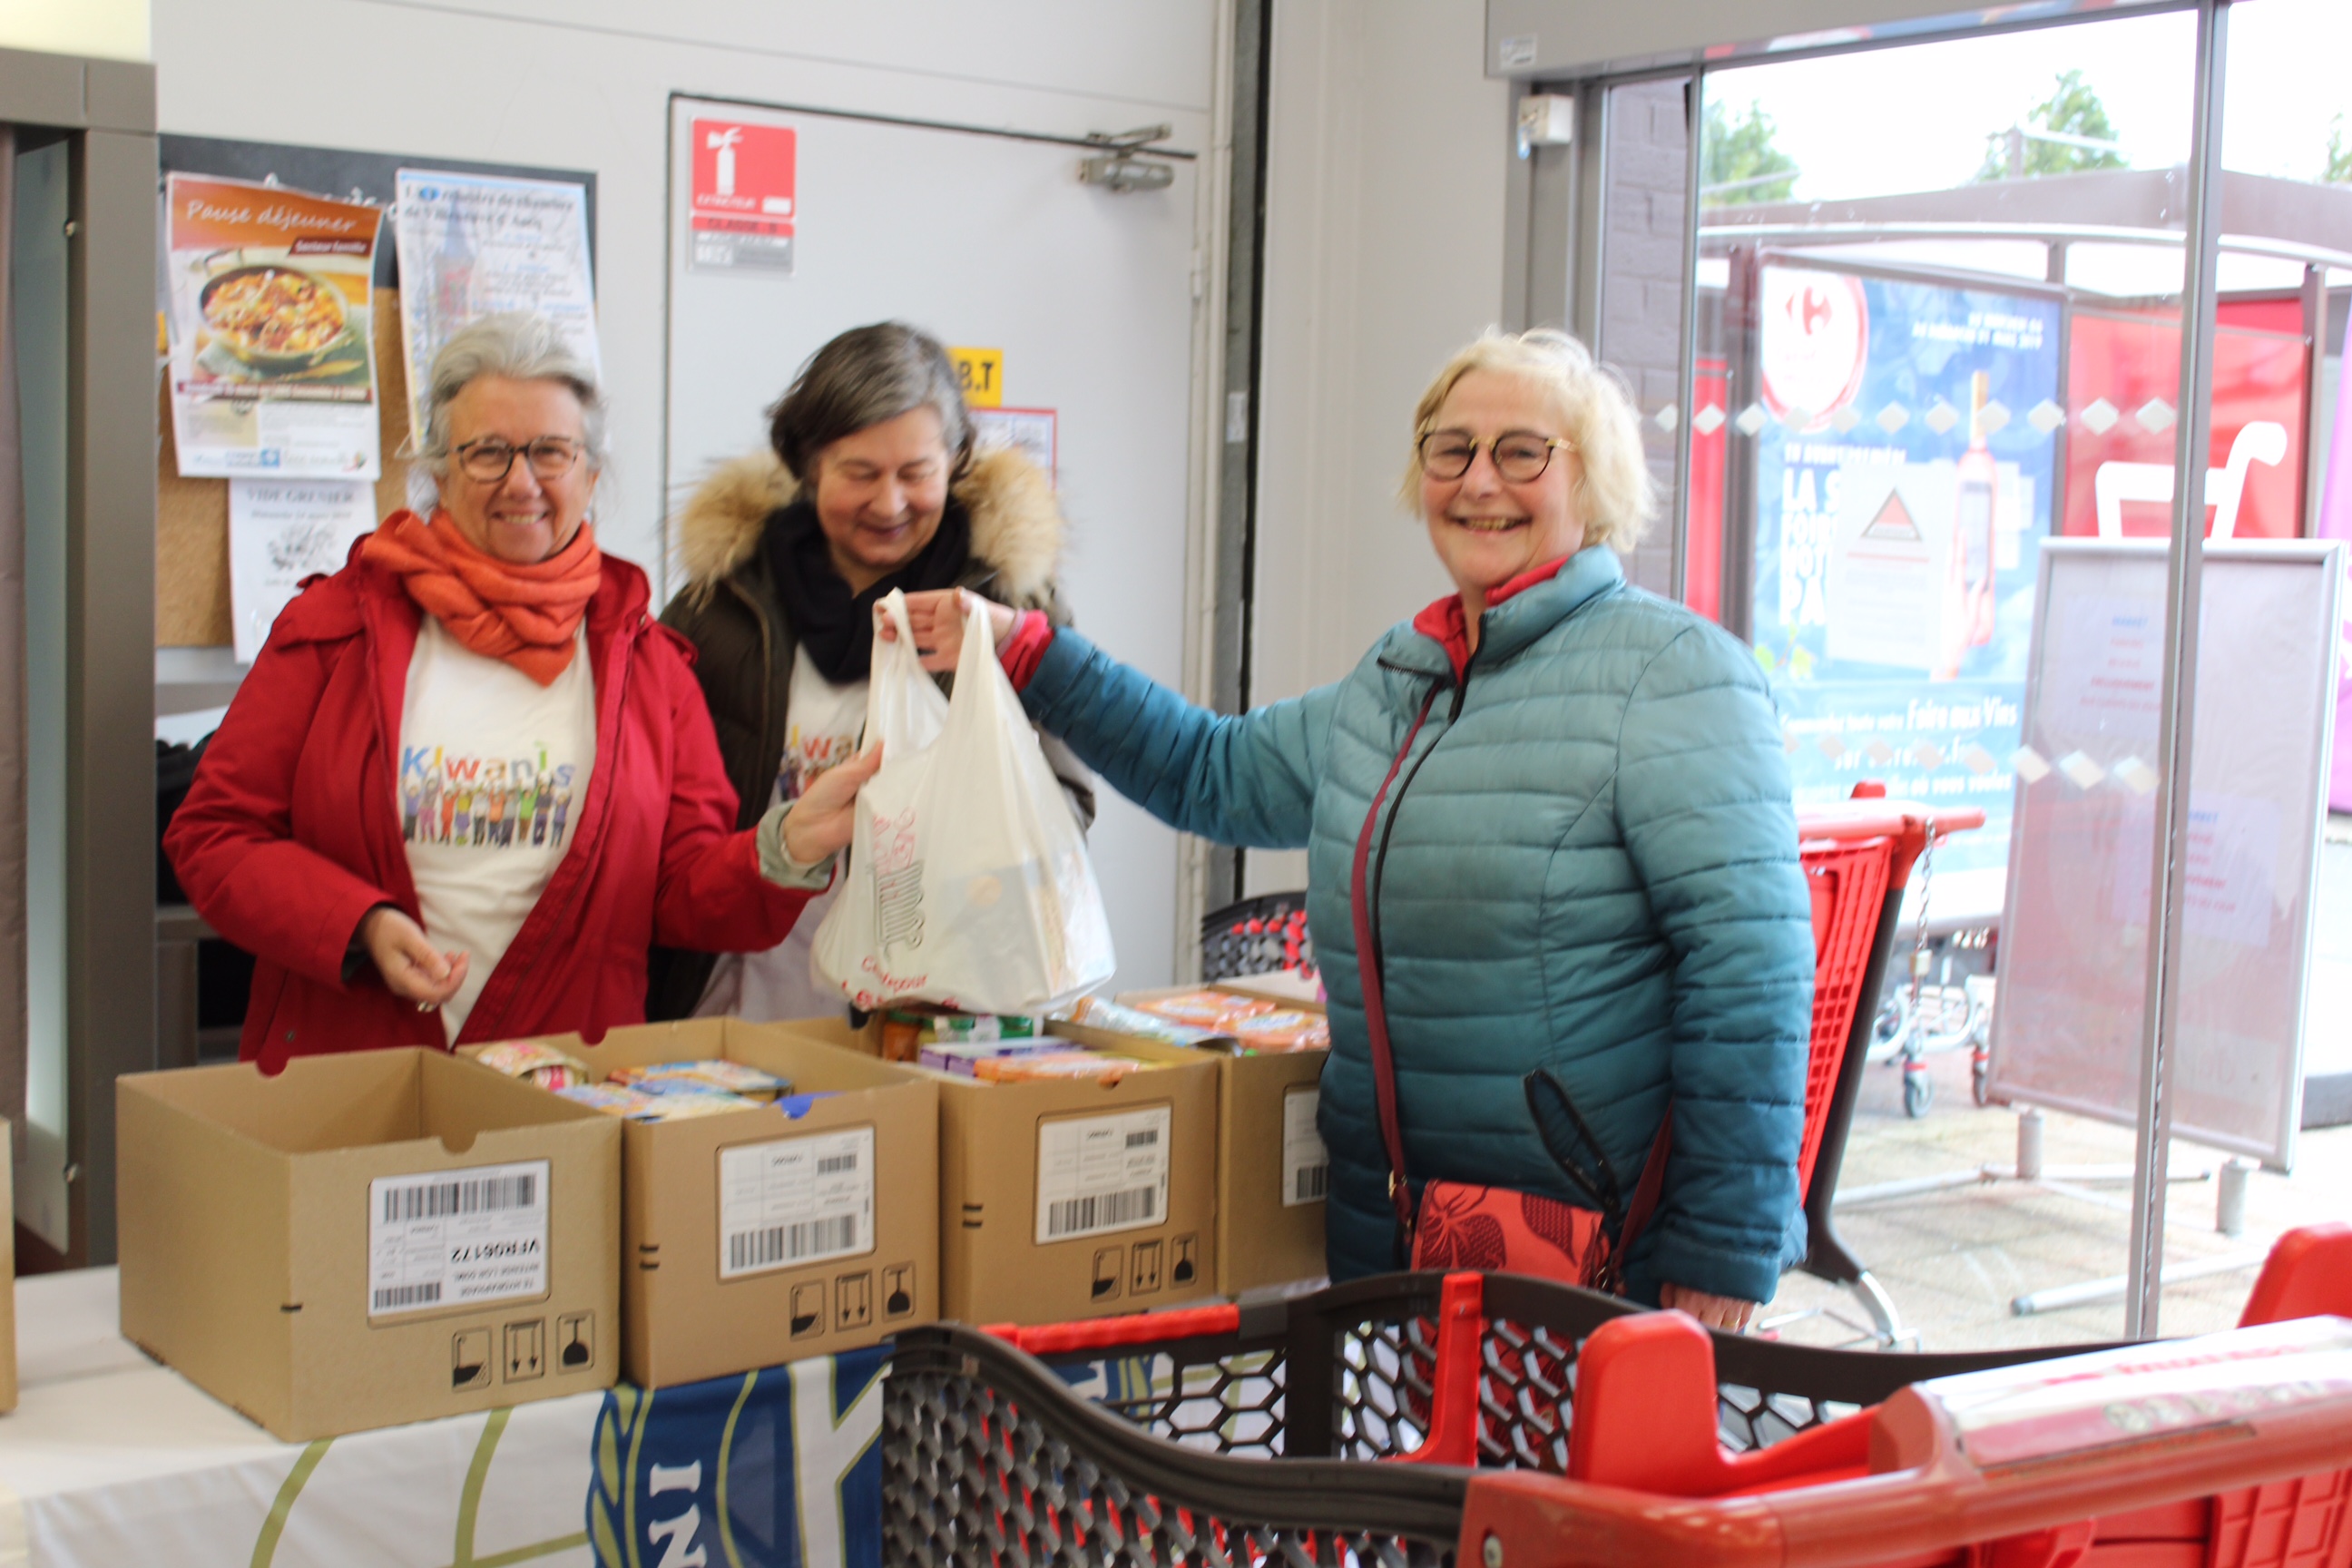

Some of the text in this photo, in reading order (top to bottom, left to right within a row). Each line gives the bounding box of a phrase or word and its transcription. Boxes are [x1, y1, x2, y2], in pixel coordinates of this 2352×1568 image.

[186, 199, 358, 232] Pause déjeuner
[1781, 466, 1817, 513] LA
[1779, 512, 1838, 549] FOIR
[1778, 575, 1828, 626] PA
[1907, 697, 1949, 730] Foire
[1950, 702, 1983, 729] aux
[1983, 694, 2019, 728] Vins
[402, 740, 575, 789] Kiwanis
[451, 1237, 542, 1264] VFR06172
